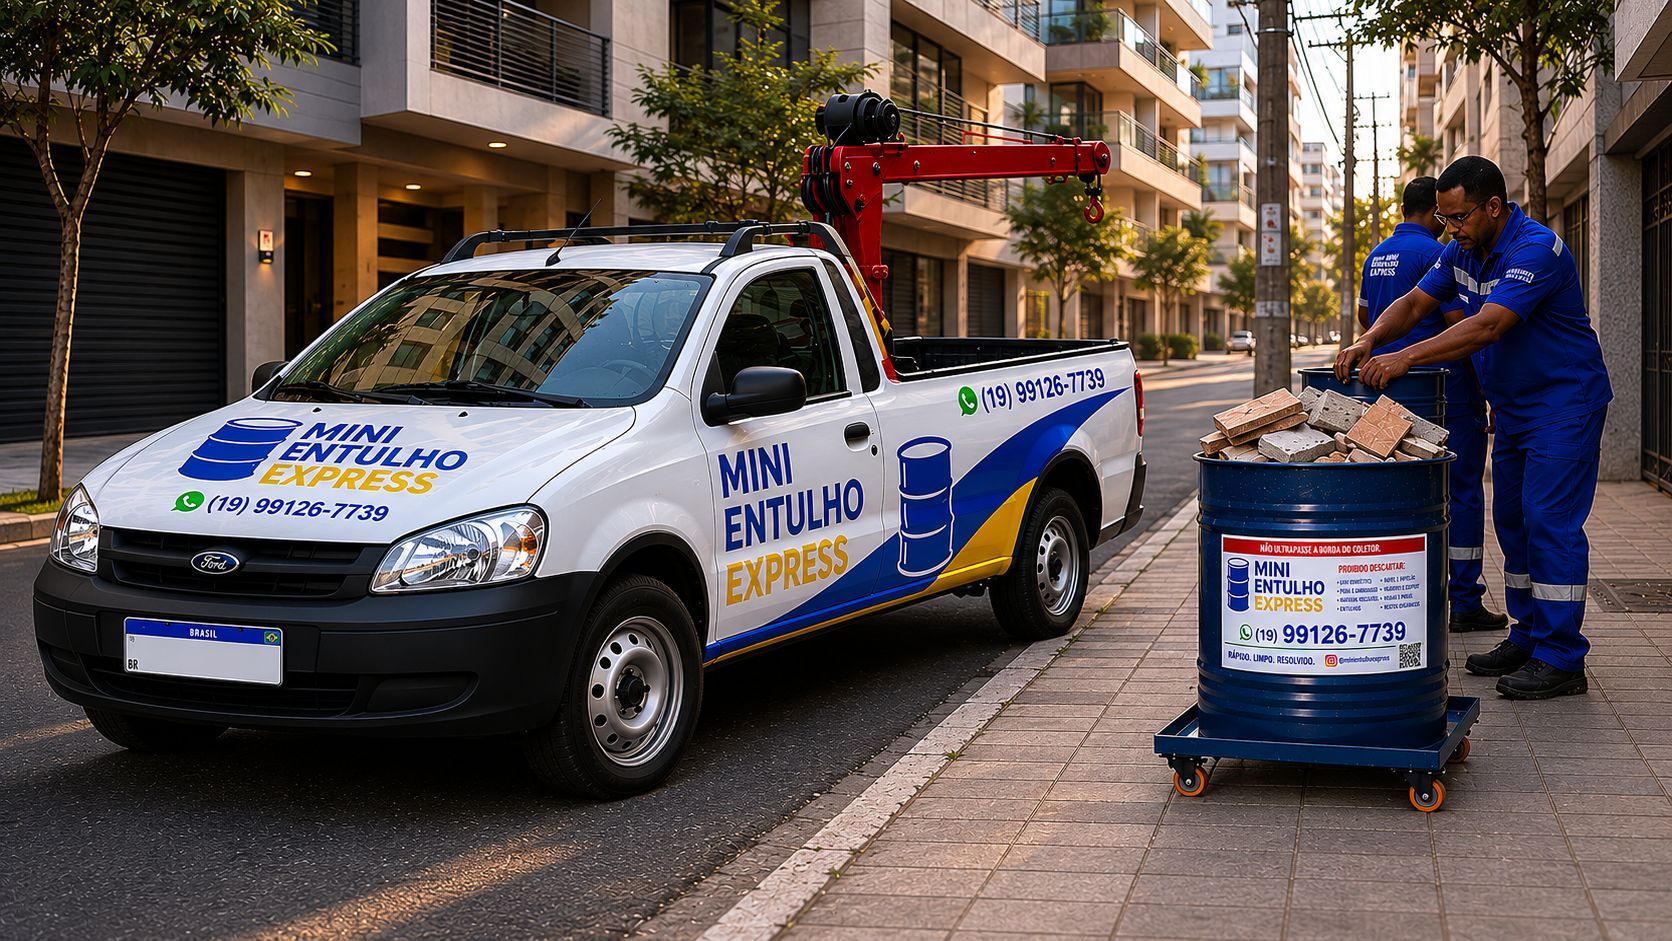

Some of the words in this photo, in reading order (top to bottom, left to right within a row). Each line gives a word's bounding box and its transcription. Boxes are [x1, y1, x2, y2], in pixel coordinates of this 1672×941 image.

[981, 382, 1013, 413] (19)
[1016, 368, 1106, 404] 99126-7739
[300, 422, 404, 445] MINI
[279, 442, 468, 471] ENTULHO
[258, 463, 440, 495] EXPRESS
[717, 443, 792, 499] MINI
[206, 495, 250, 516] (19)
[253, 497, 389, 522] 99126-7739
[725, 478, 864, 552] ENTULHO
[1259, 542, 1273, 553] NÃO
[1313, 546, 1318, 554] A
[200, 554, 228, 572] Ford
[726, 534, 848, 606] EXPRESS
[1254, 560, 1290, 578] MINI
[1254, 579, 1325, 596] ENTULHO
[1254, 595, 1323, 613] EXPRESS
[190, 628, 217, 639] BRASIL
[1255, 628, 1278, 644] (19)
[1282, 621, 1406, 645] 99126-7739
[127, 659, 139, 670] BR
[1253, 653, 1275, 664] LIMPO.
[1276, 655, 1316, 666] RESOLVIDO.
